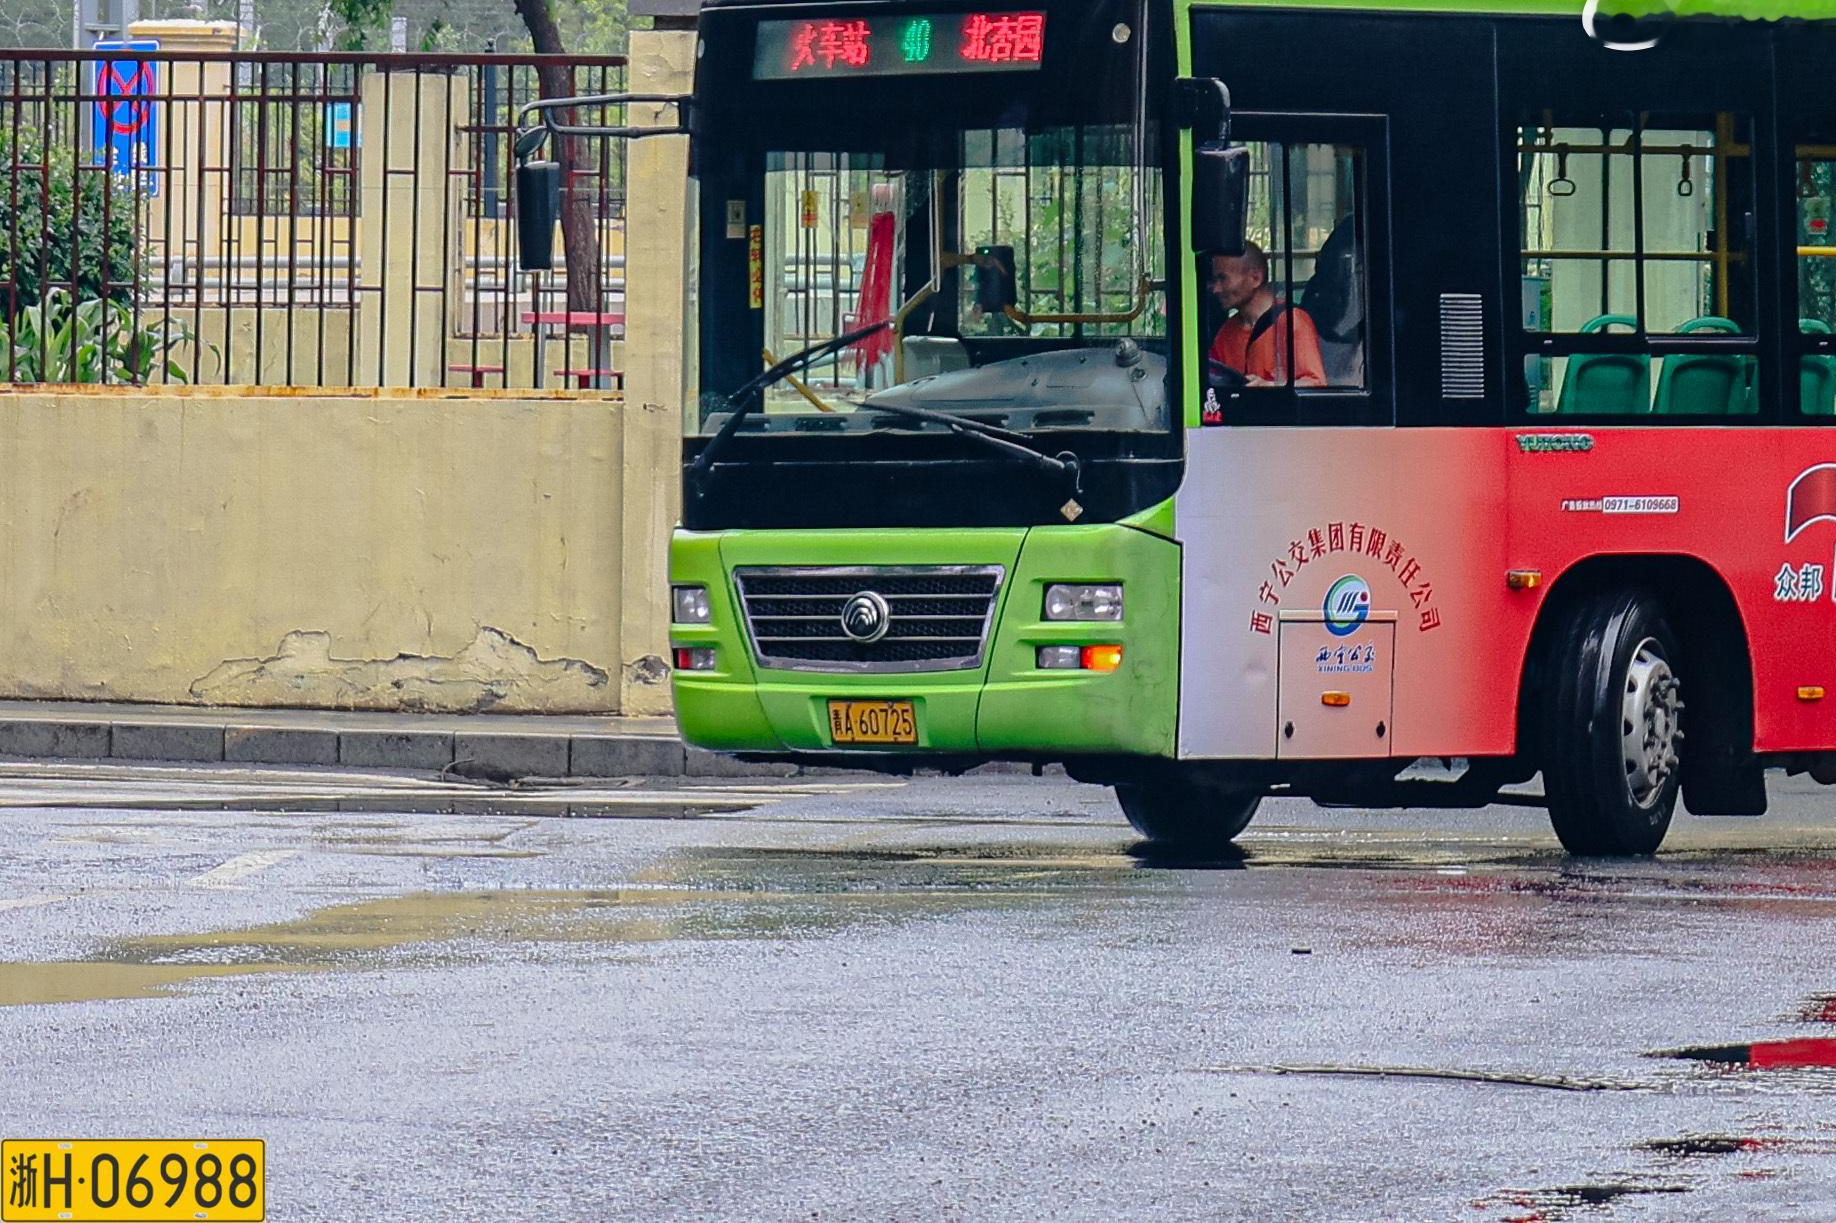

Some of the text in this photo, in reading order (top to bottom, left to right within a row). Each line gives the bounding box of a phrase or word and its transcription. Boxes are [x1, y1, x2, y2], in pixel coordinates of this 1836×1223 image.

[791, 19, 871, 72] 火车站
[902, 19, 931, 62] 40
[1249, 521, 1441, 634] 西宁公交集团有限责任公司
[1774, 562, 1823, 602] 众邦
